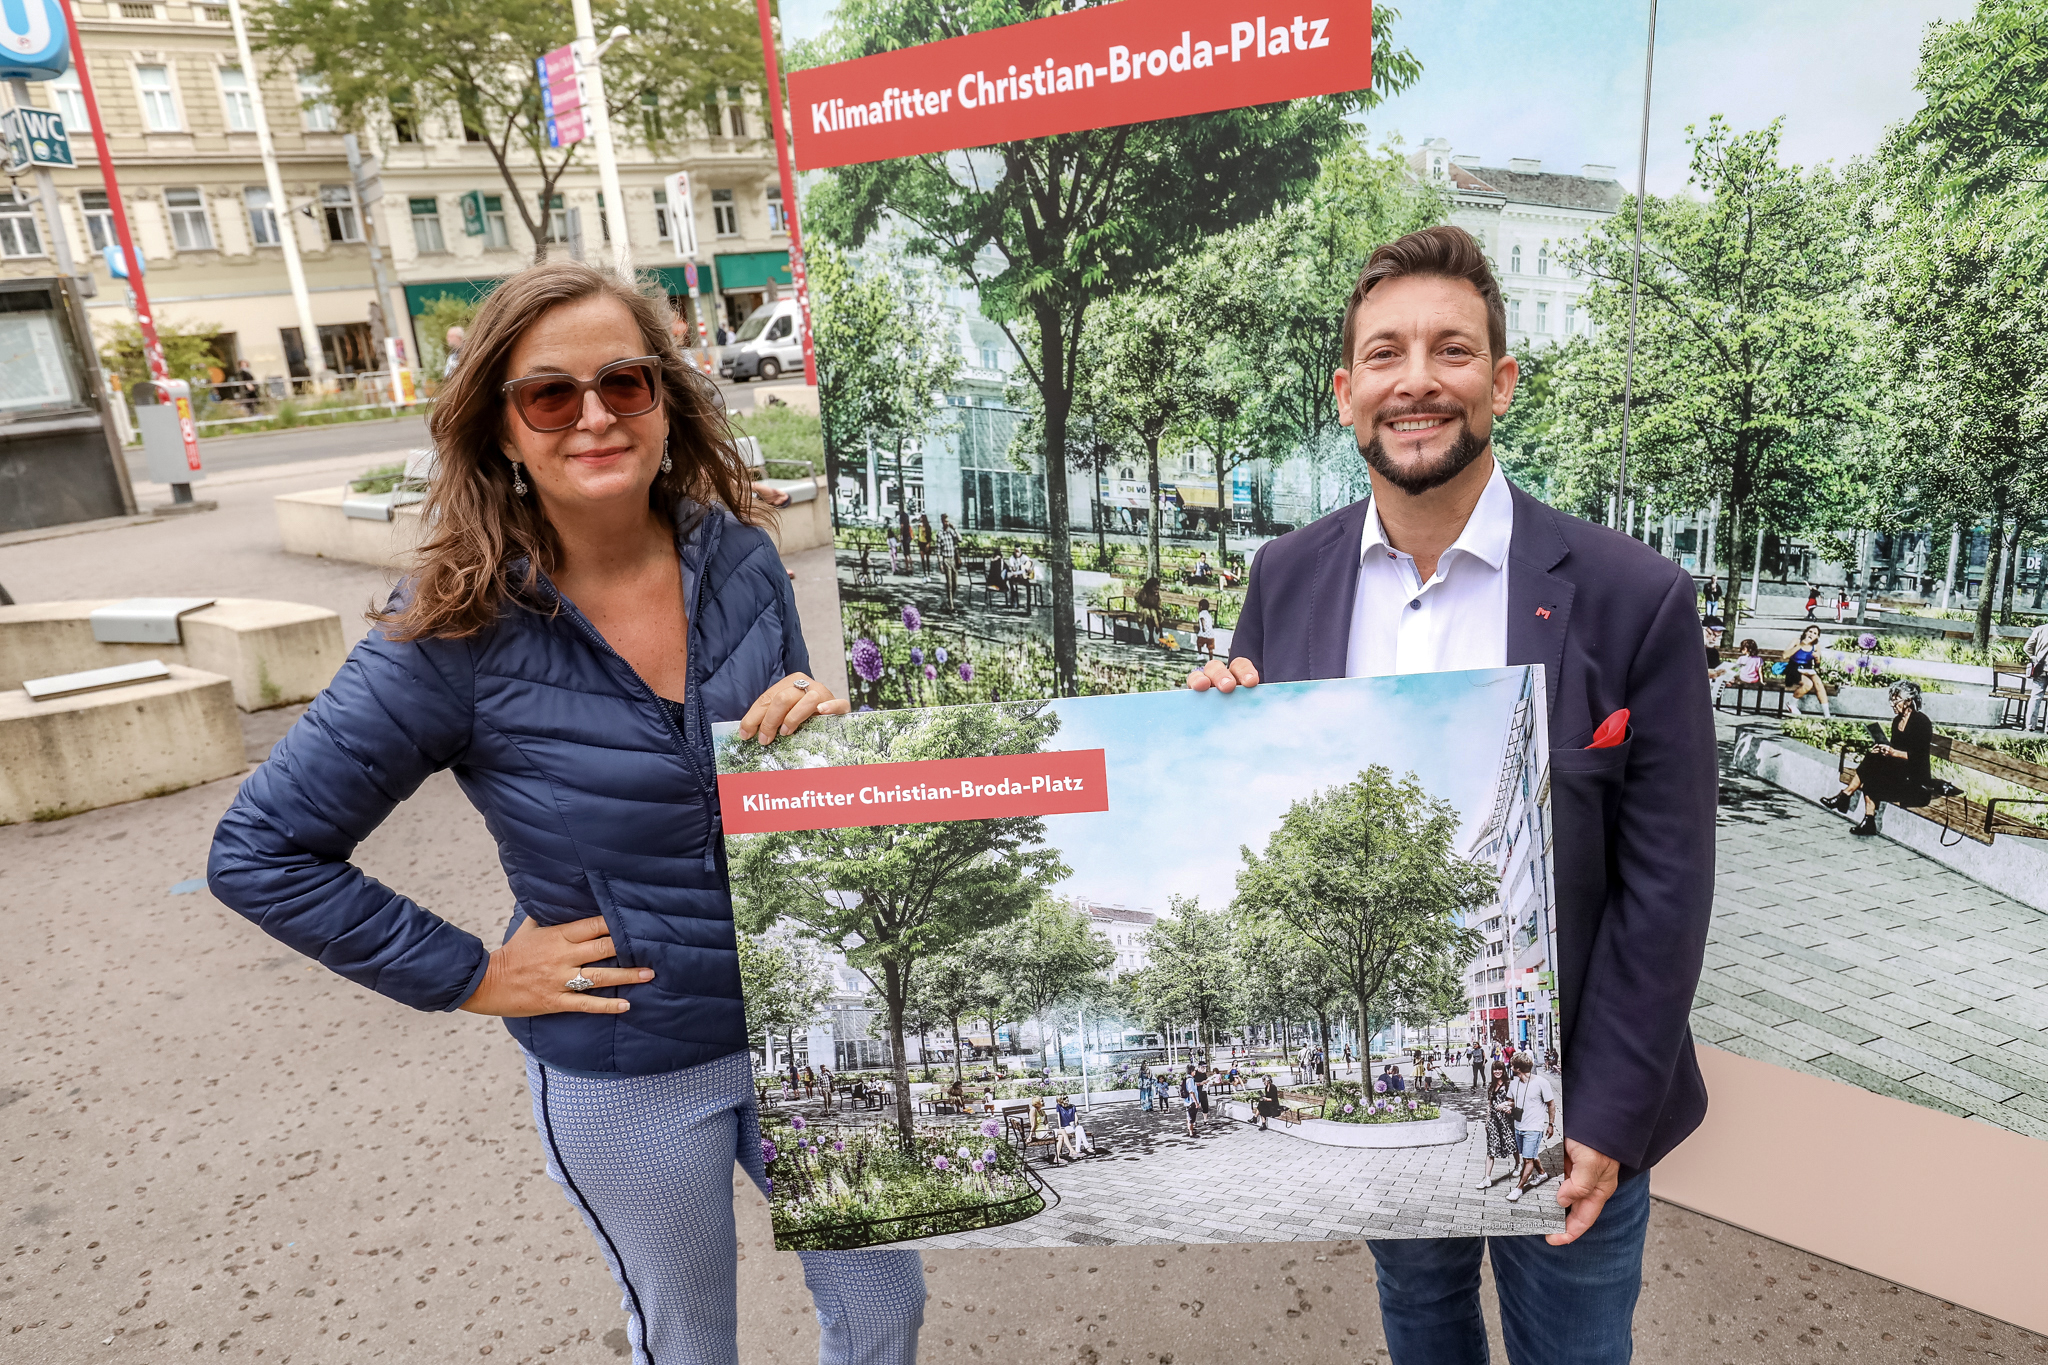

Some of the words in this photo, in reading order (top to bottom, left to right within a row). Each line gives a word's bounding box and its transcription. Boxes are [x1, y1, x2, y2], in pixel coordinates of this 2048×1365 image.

[811, 87, 953, 134] Klimafitter
[957, 14, 1330, 109] Christian-Broda-Platz
[22, 111, 66, 142] WC
[1779, 546, 1801, 556] WRK
[687, 679, 696, 705] TOM
[686, 707, 696, 747] TAILOR
[743, 790, 854, 812] Klimafitter
[858, 774, 1084, 805] Christian-Broda-Platz
